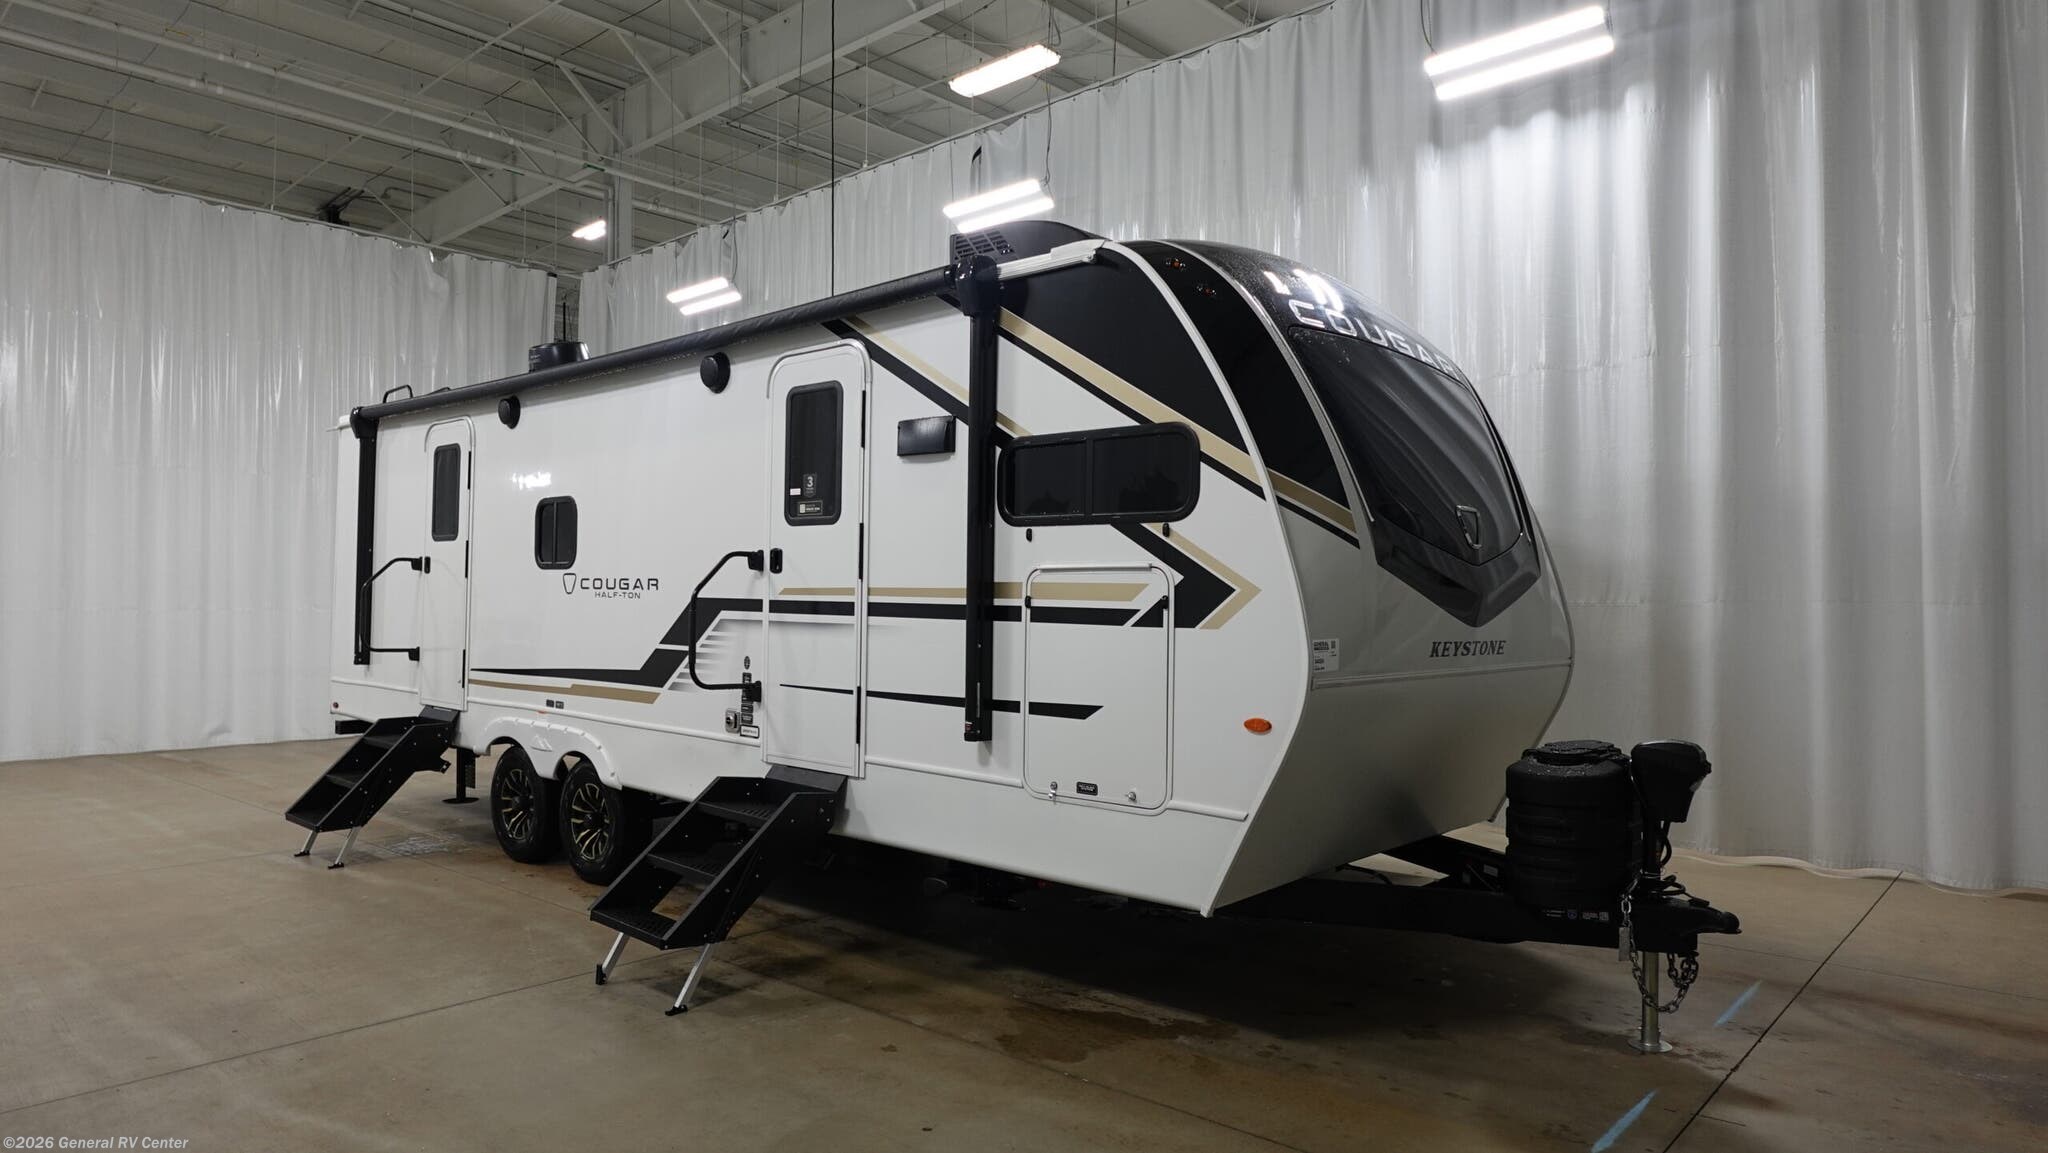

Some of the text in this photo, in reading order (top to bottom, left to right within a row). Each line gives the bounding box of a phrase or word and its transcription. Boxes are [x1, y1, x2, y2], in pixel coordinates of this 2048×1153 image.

[1288, 298, 1462, 382] COUGAR
[807, 476, 814, 487] 3
[580, 577, 660, 591] COUGAR
[594, 591, 641, 600] HALF-TON
[1429, 640, 1507, 658] KEYSTONE
